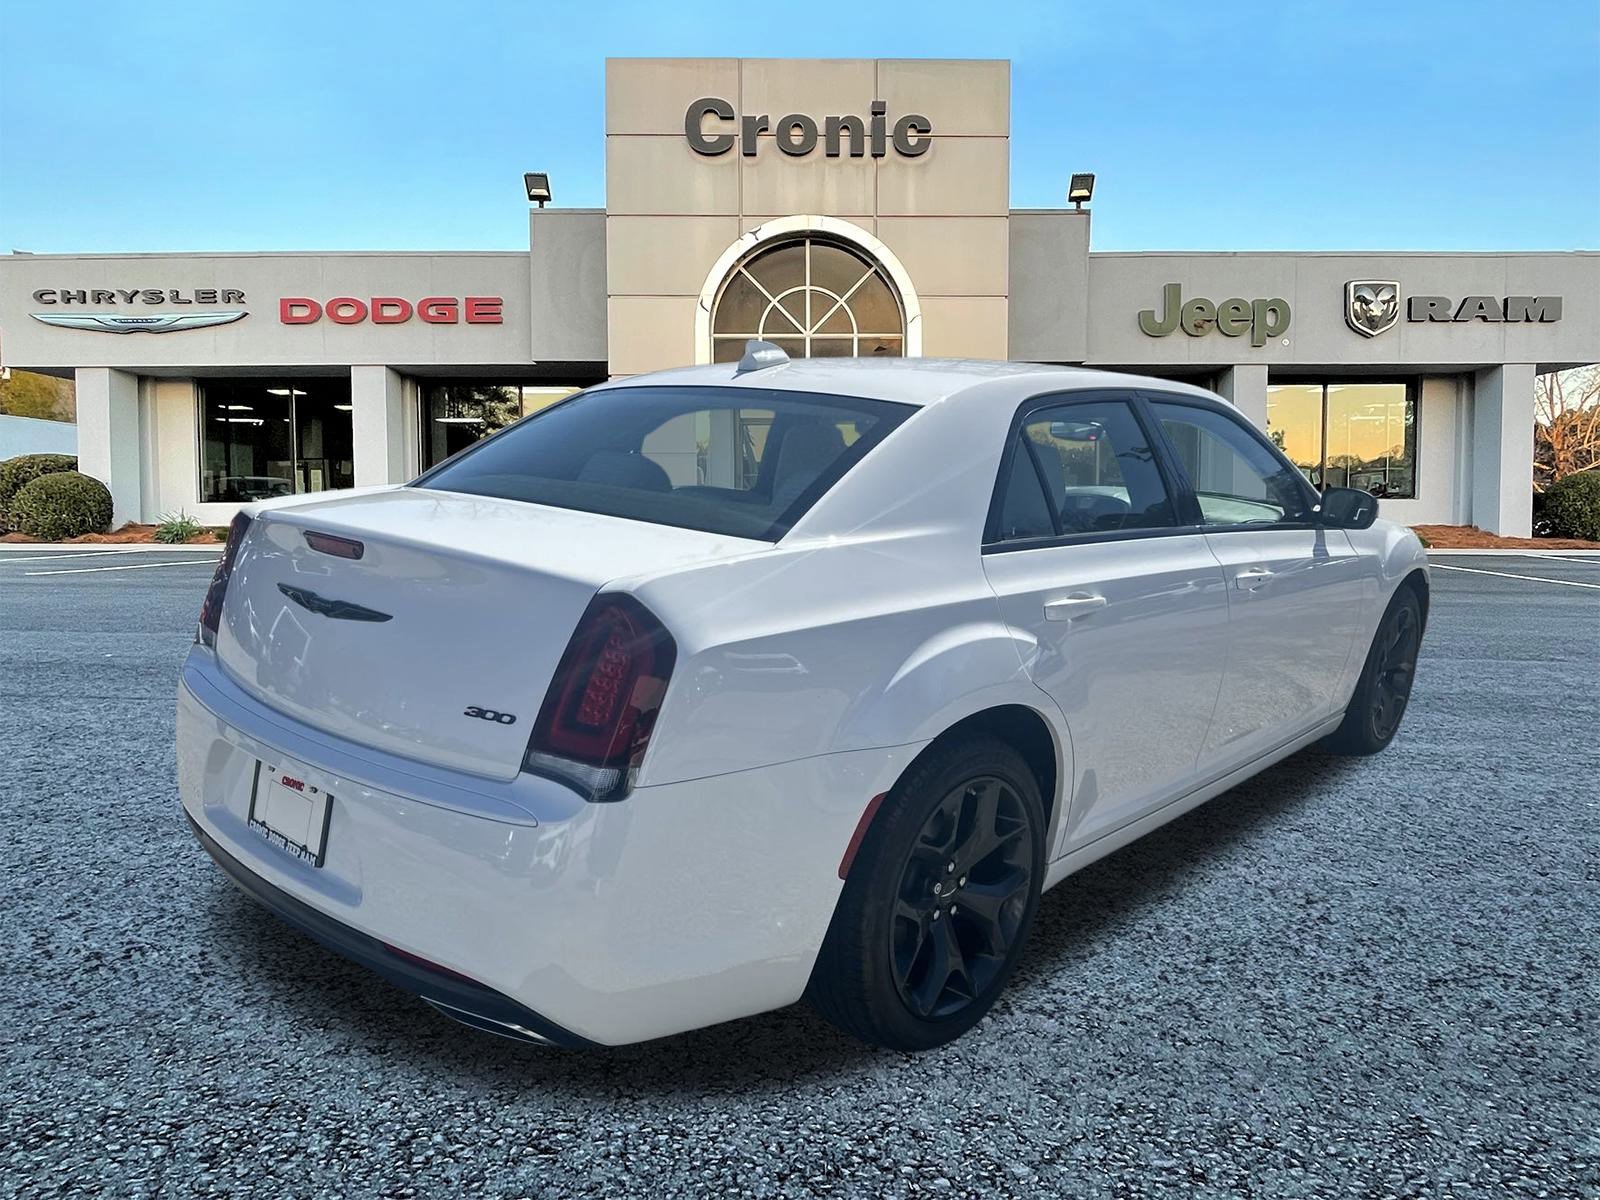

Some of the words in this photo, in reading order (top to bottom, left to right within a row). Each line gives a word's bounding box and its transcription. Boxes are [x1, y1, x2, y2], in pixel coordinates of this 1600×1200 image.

[685, 97, 932, 157] Cronic
[32, 289, 248, 305] CHRYSLER
[280, 297, 503, 325] DODGE
[1407, 295, 1563, 323] RAM
[1138, 283, 1292, 347] Jeep
[464, 706, 517, 725] 300
